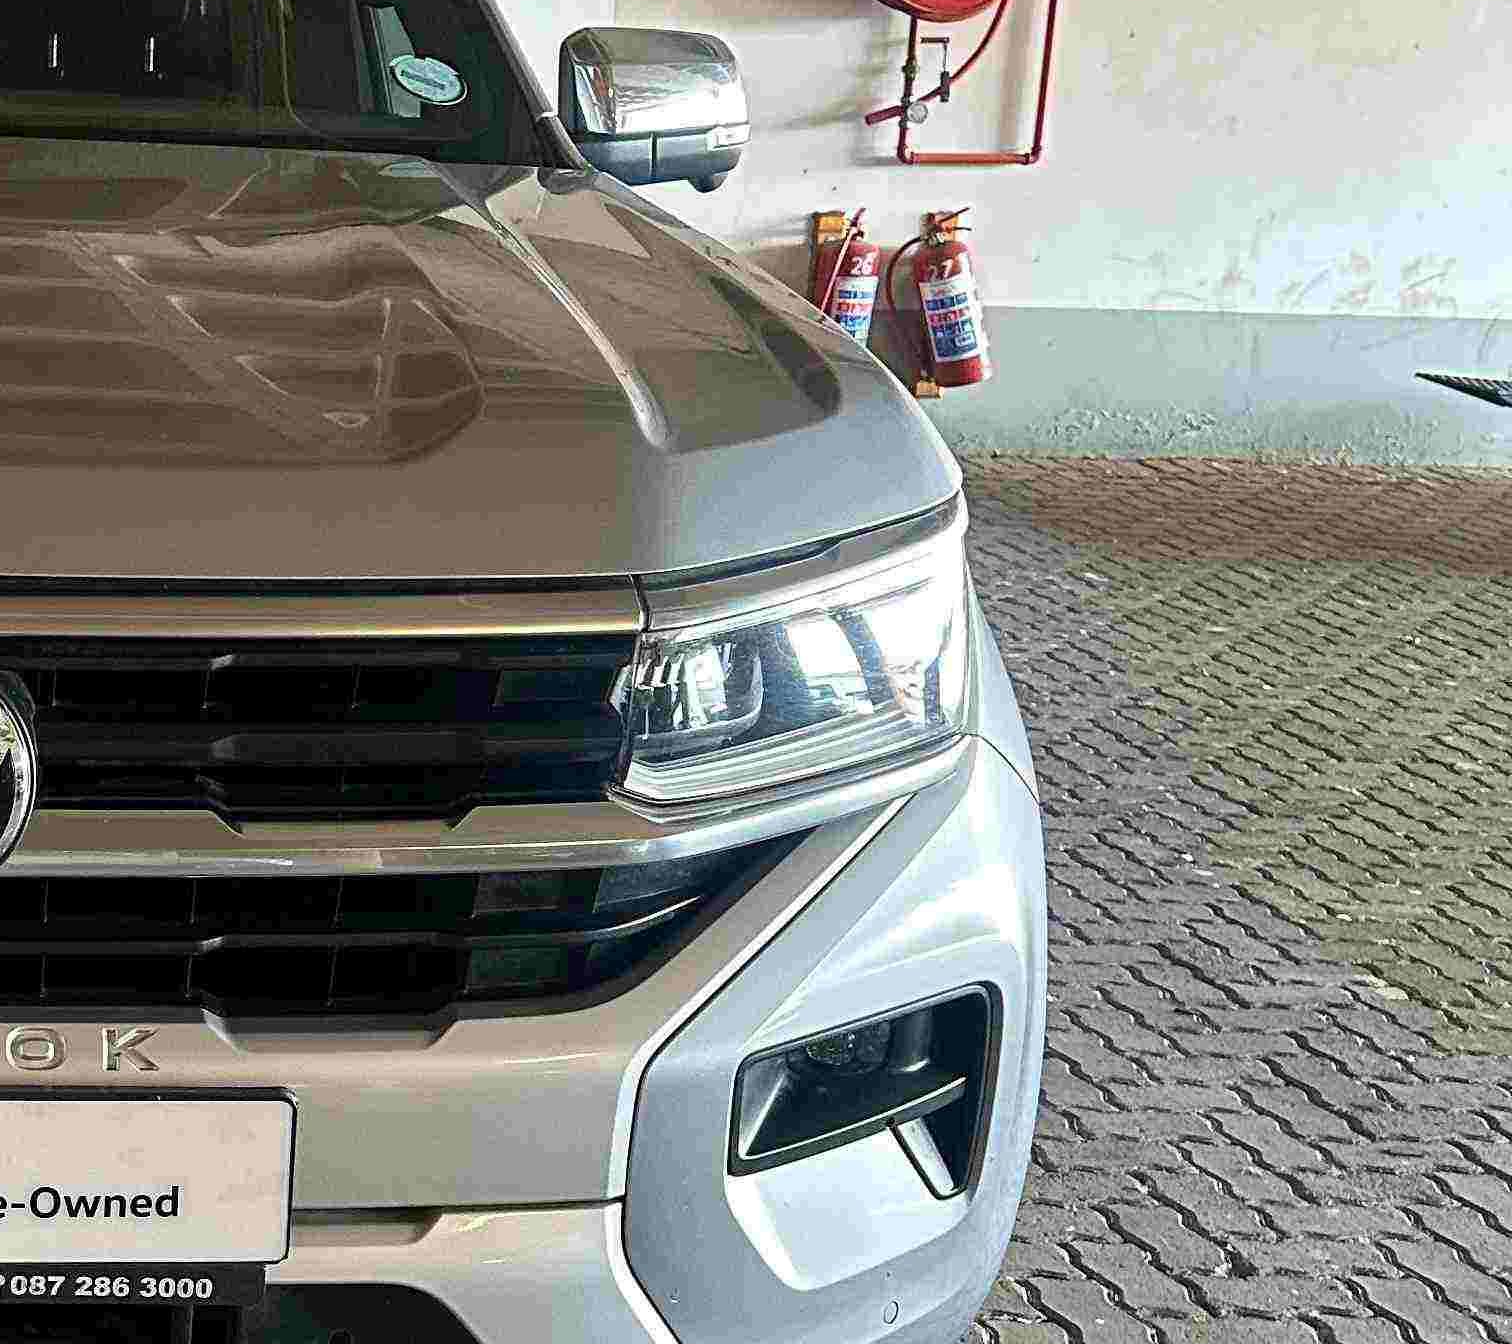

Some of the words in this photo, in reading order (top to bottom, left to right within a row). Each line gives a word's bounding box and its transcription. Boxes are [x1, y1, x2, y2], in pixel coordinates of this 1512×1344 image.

[10, 1275, 65, 1297] 087
[74, 1275, 130, 1297] 286
[139, 1276, 213, 1299] 3000
